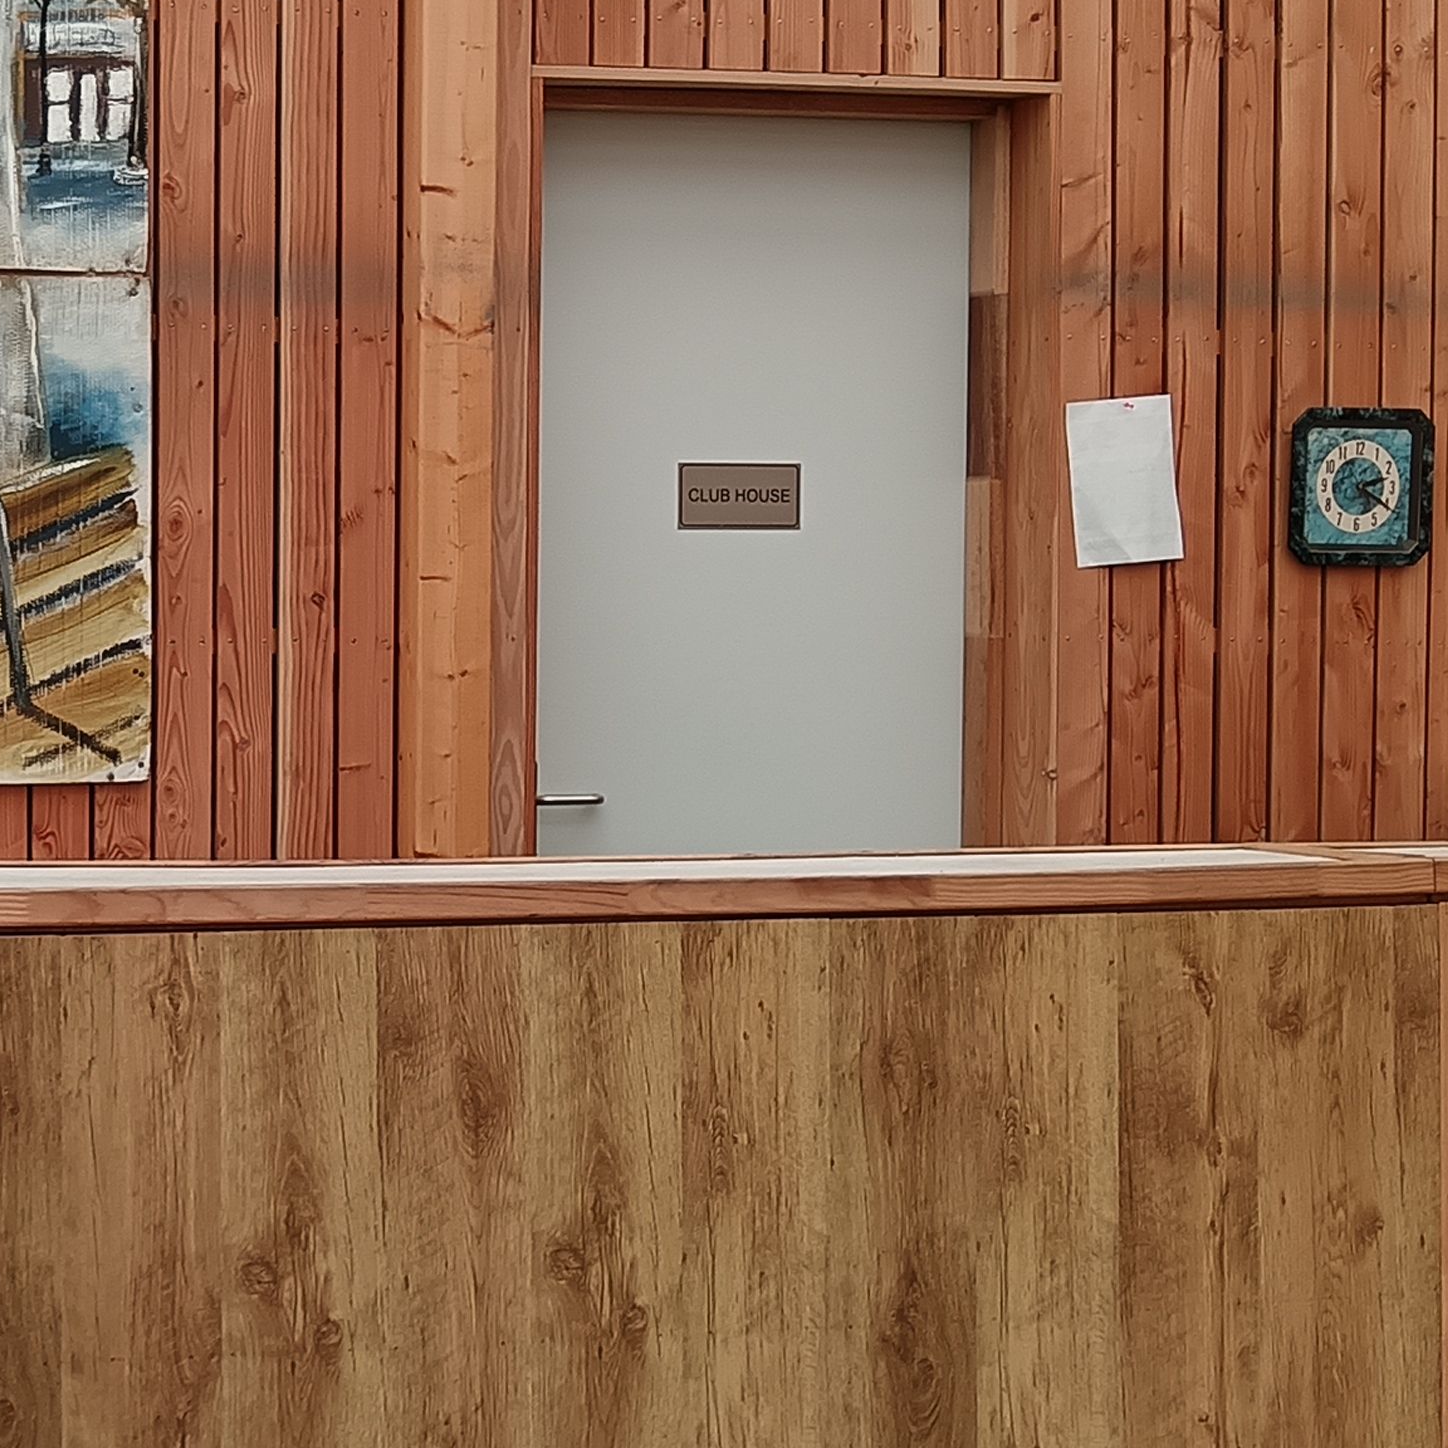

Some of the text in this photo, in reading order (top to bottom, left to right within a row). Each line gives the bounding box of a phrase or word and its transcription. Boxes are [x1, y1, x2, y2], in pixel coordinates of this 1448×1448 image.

[1339, 447, 1347, 460] 11
[1356, 442, 1365, 456] 12
[1326, 459, 1335, 474] 10
[1385, 461, 1392, 474] 2
[1321, 478, 1327, 493] 9
[1389, 480, 1395, 495] 3
[688, 487, 791, 503] CLUB HOUSE
[1325, 498, 1331, 512] 8
[1337, 512, 1342, 526] 7
[1353, 517, 1360, 531] 6
[1371, 513, 1377, 526] 5
